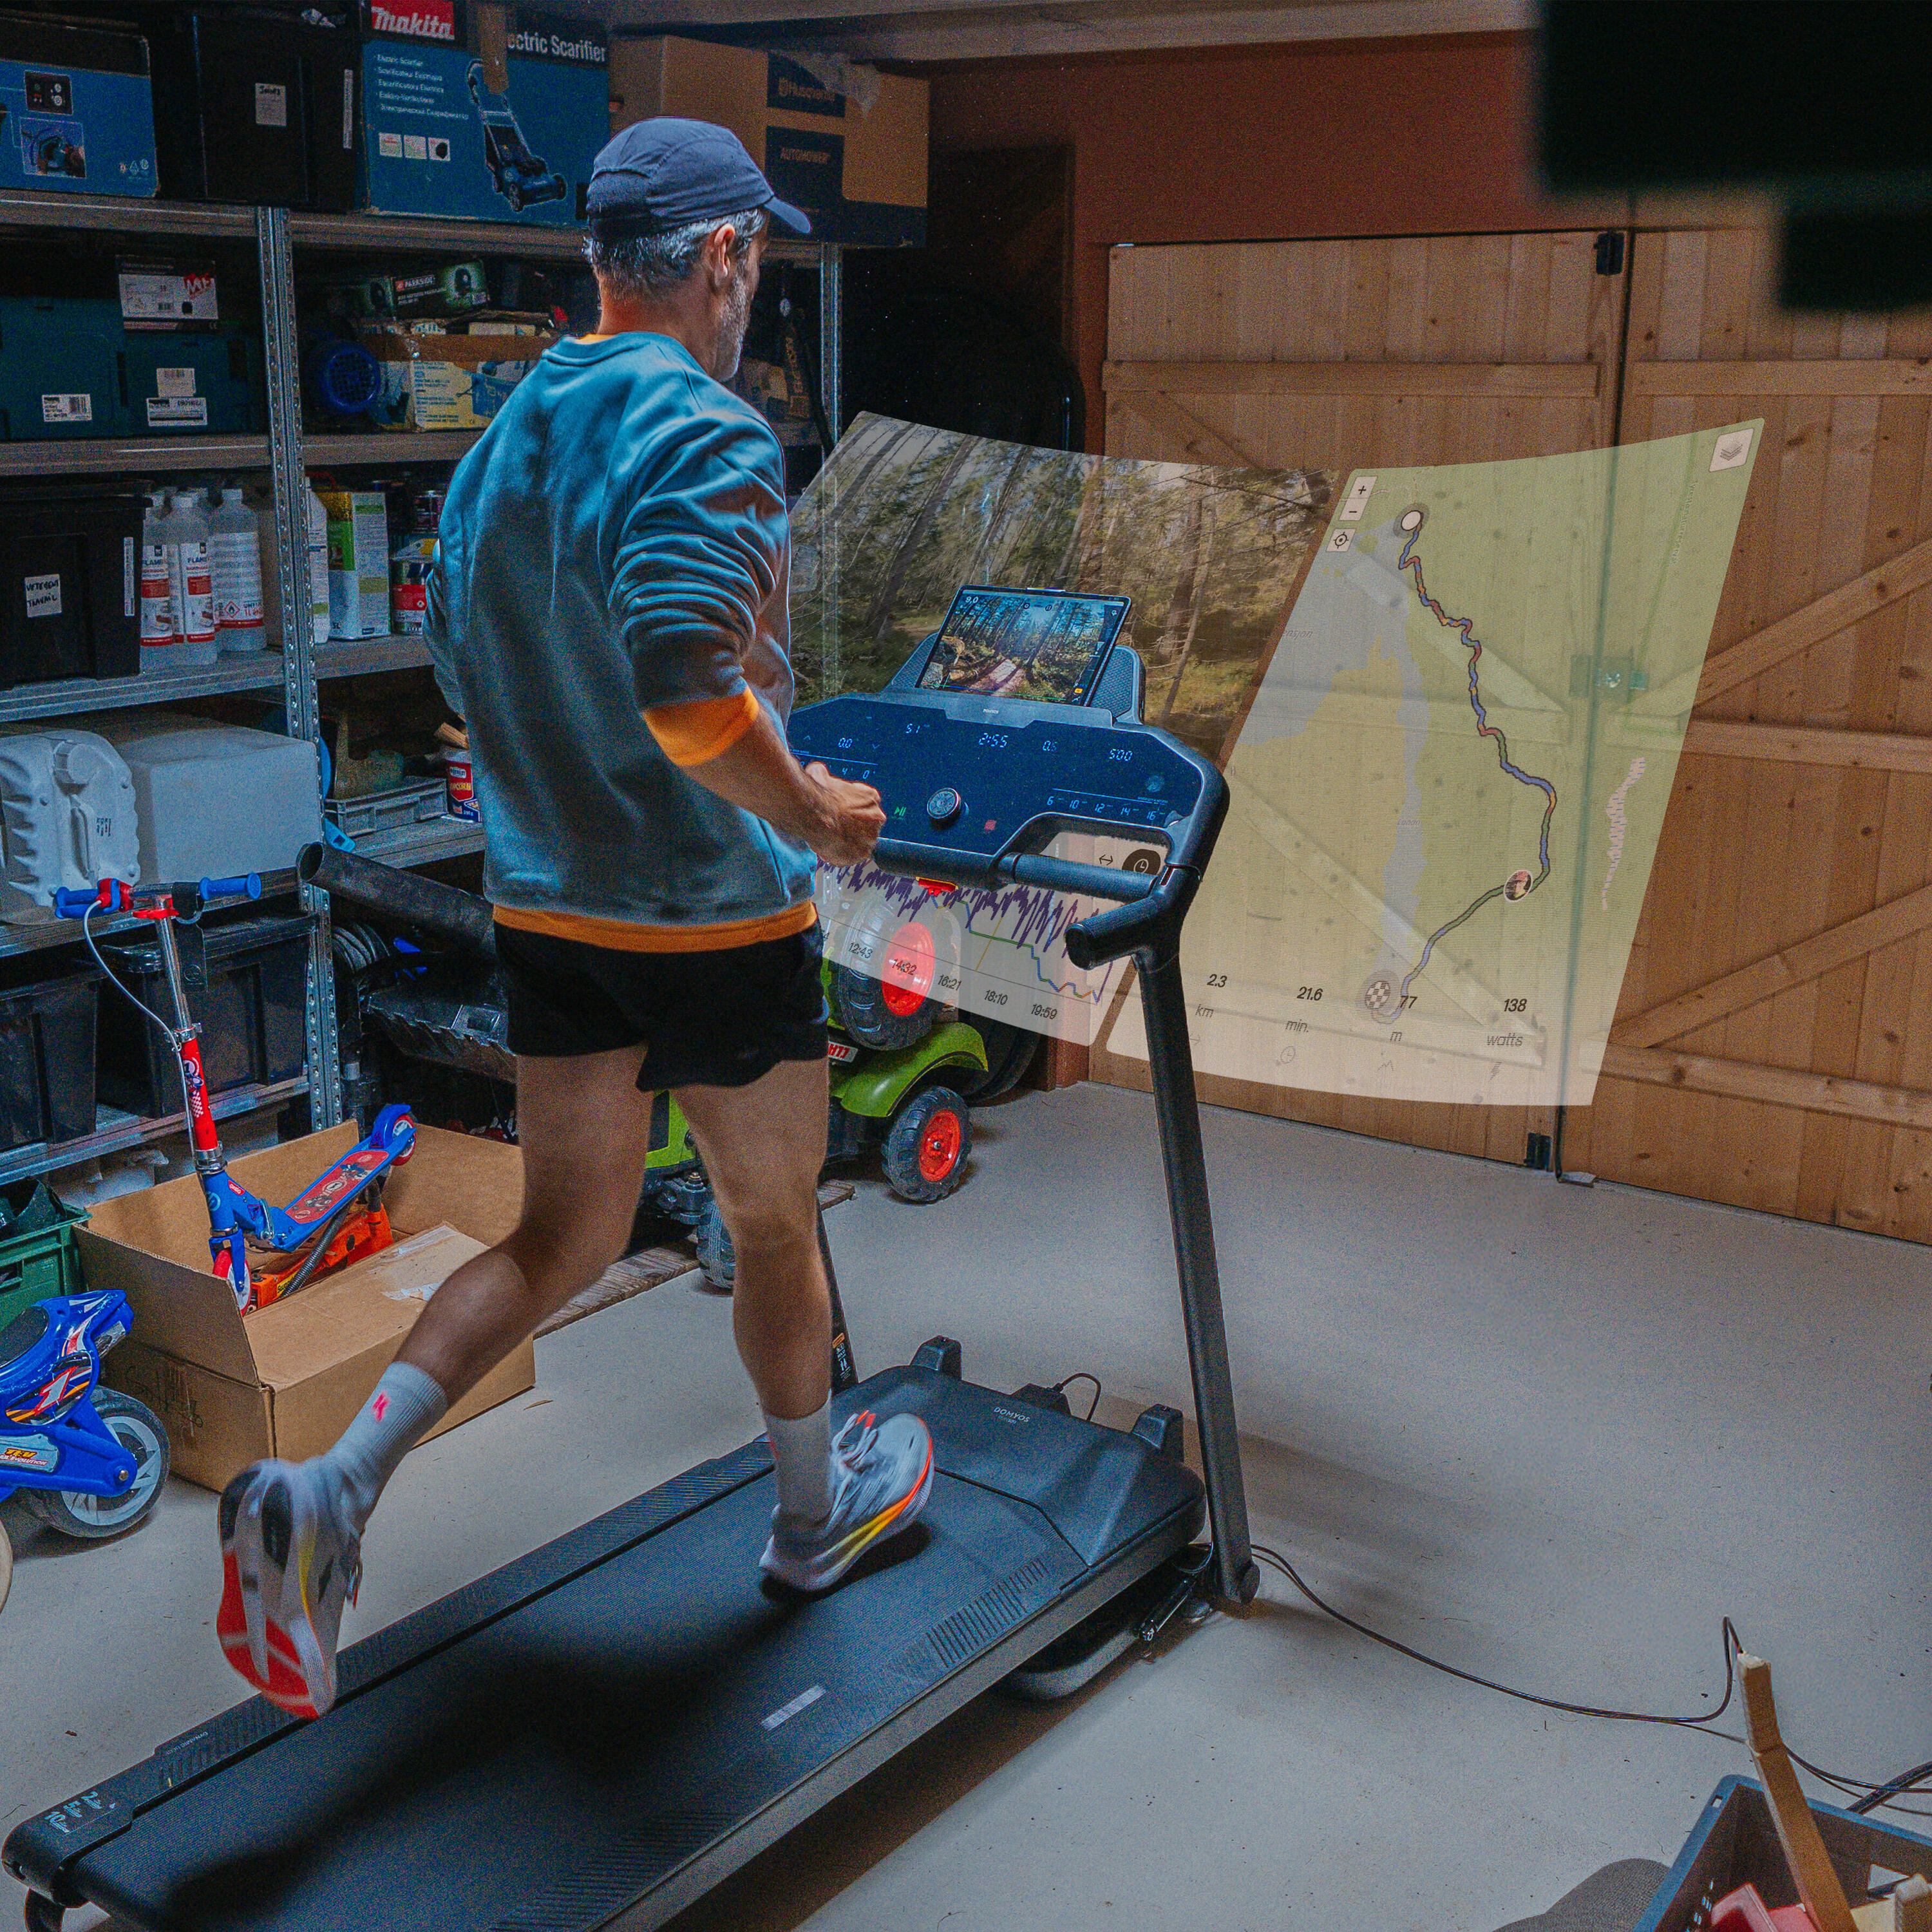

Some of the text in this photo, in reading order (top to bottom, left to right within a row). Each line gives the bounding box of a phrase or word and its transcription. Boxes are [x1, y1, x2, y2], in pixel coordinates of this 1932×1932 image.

[551, 35, 607, 62] Scarifier
[978, 732, 1009, 748] 2:55
[1046, 796, 1157, 820] 6 10 12 14 16
[848, 942, 1058, 1021] 12:43 14:32 16:21 18:10 19:59
[1206, 973, 1528, 1012] 2.3 21.6 77 138
[1195, 1003, 1524, 1046] km min. m watts
[994, 1406, 1030, 1422] DOMYOS
